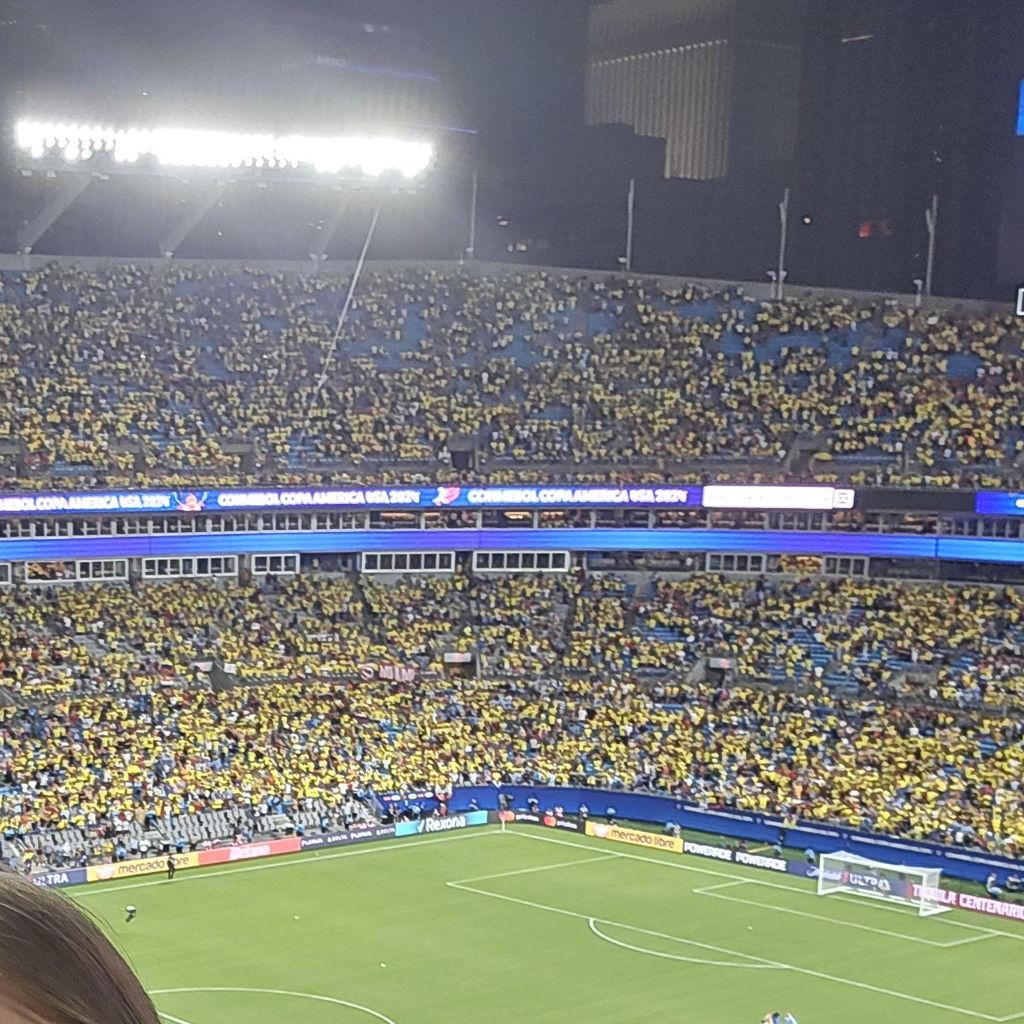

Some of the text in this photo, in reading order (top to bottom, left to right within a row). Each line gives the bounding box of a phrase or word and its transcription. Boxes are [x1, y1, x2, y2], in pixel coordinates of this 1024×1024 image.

[426, 816, 465, 832] Rexona
[611, 829, 675, 849] mercado libre
[118, 859, 164, 874] mercado
